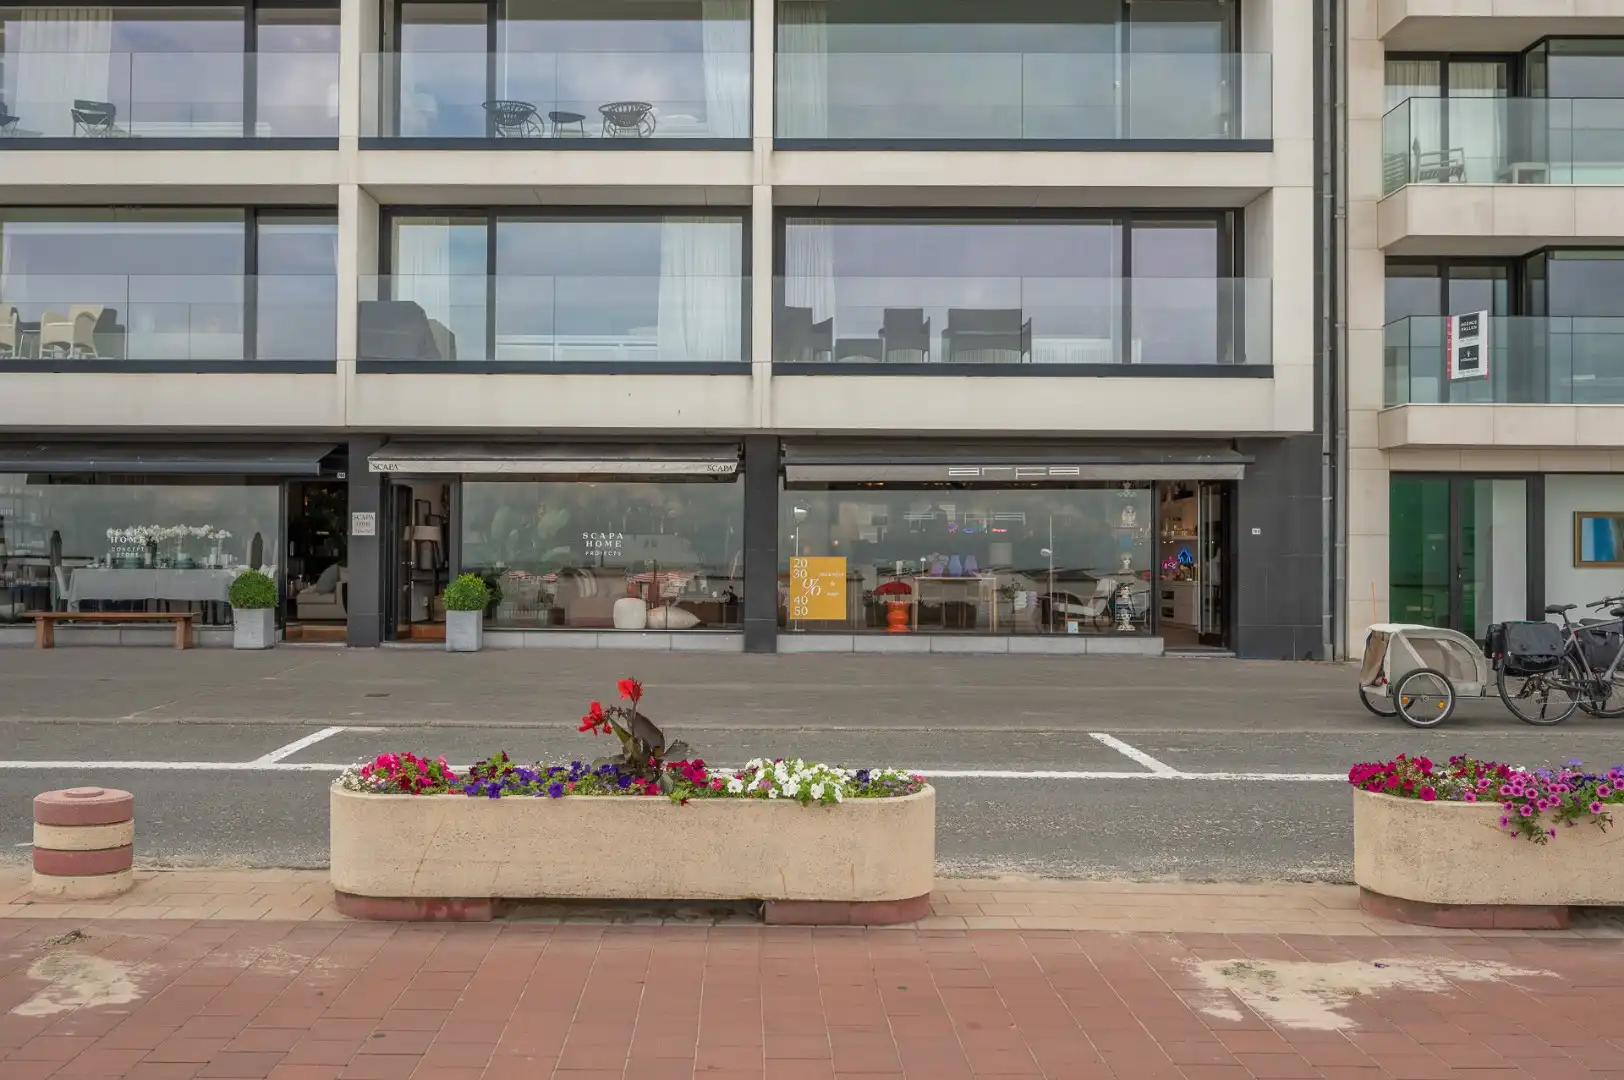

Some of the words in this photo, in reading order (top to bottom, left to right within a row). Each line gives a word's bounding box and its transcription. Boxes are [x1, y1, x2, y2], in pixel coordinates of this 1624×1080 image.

[372, 463, 399, 471] SCAPA
[707, 464, 733, 472] SCAPA
[110, 536, 146, 544] HOME
[582, 532, 624, 540] SCAPA
[585, 540, 622, 548] HOME
[793, 558, 808, 568] 20
[793, 568, 808, 579] 30
[793, 595, 809, 605] 40
[793, 606, 809, 616] 50
